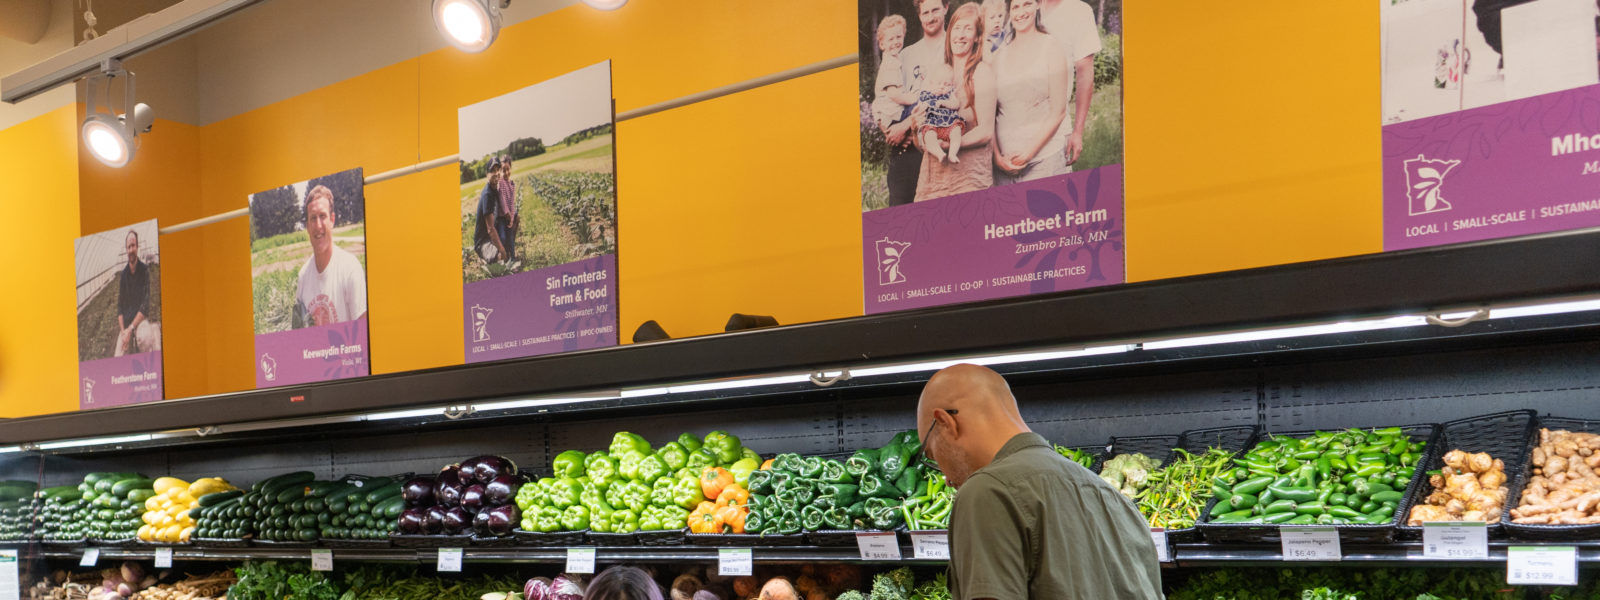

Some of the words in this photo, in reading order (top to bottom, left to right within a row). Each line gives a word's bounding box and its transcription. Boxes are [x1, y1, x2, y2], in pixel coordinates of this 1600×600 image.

[1551, 133, 1600, 156] Mho
[984, 213, 1061, 240] Heartbeet
[1065, 208, 1107, 226] Farm
[1406, 223, 1440, 237] LOCAL
[1452, 210, 1526, 231] SMALL-SCALE
[1540, 199, 1600, 218] SUSTAINA
[1015, 240, 1057, 254] Zumbro
[1059, 235, 1085, 248] Falls,
[1087, 230, 1108, 243] MN
[546, 277, 561, 290] Sin
[562, 270, 607, 287] Fronteras
[878, 292, 899, 302] LOCAL
[906, 284, 952, 299] SMALL-SCALE
[960, 280, 984, 291] CO-OP
[992, 271, 1042, 287] SUSTAINABLE
[1043, 265, 1087, 280] PRACTICES
[550, 294, 574, 307] Farm
[575, 290, 582, 302] &
[583, 284, 607, 300] Food
[595, 304, 608, 314] MN
[303, 345, 339, 359] Keewaydin
[340, 344, 362, 354] Farms
[490, 341, 518, 351] SMALL-SCALE
[521, 336, 551, 346] SUSTAINABLE
[551, 331, 576, 341] PRACTICES
[111, 374, 143, 384] Featherstone
[143, 371, 158, 380] Farm
